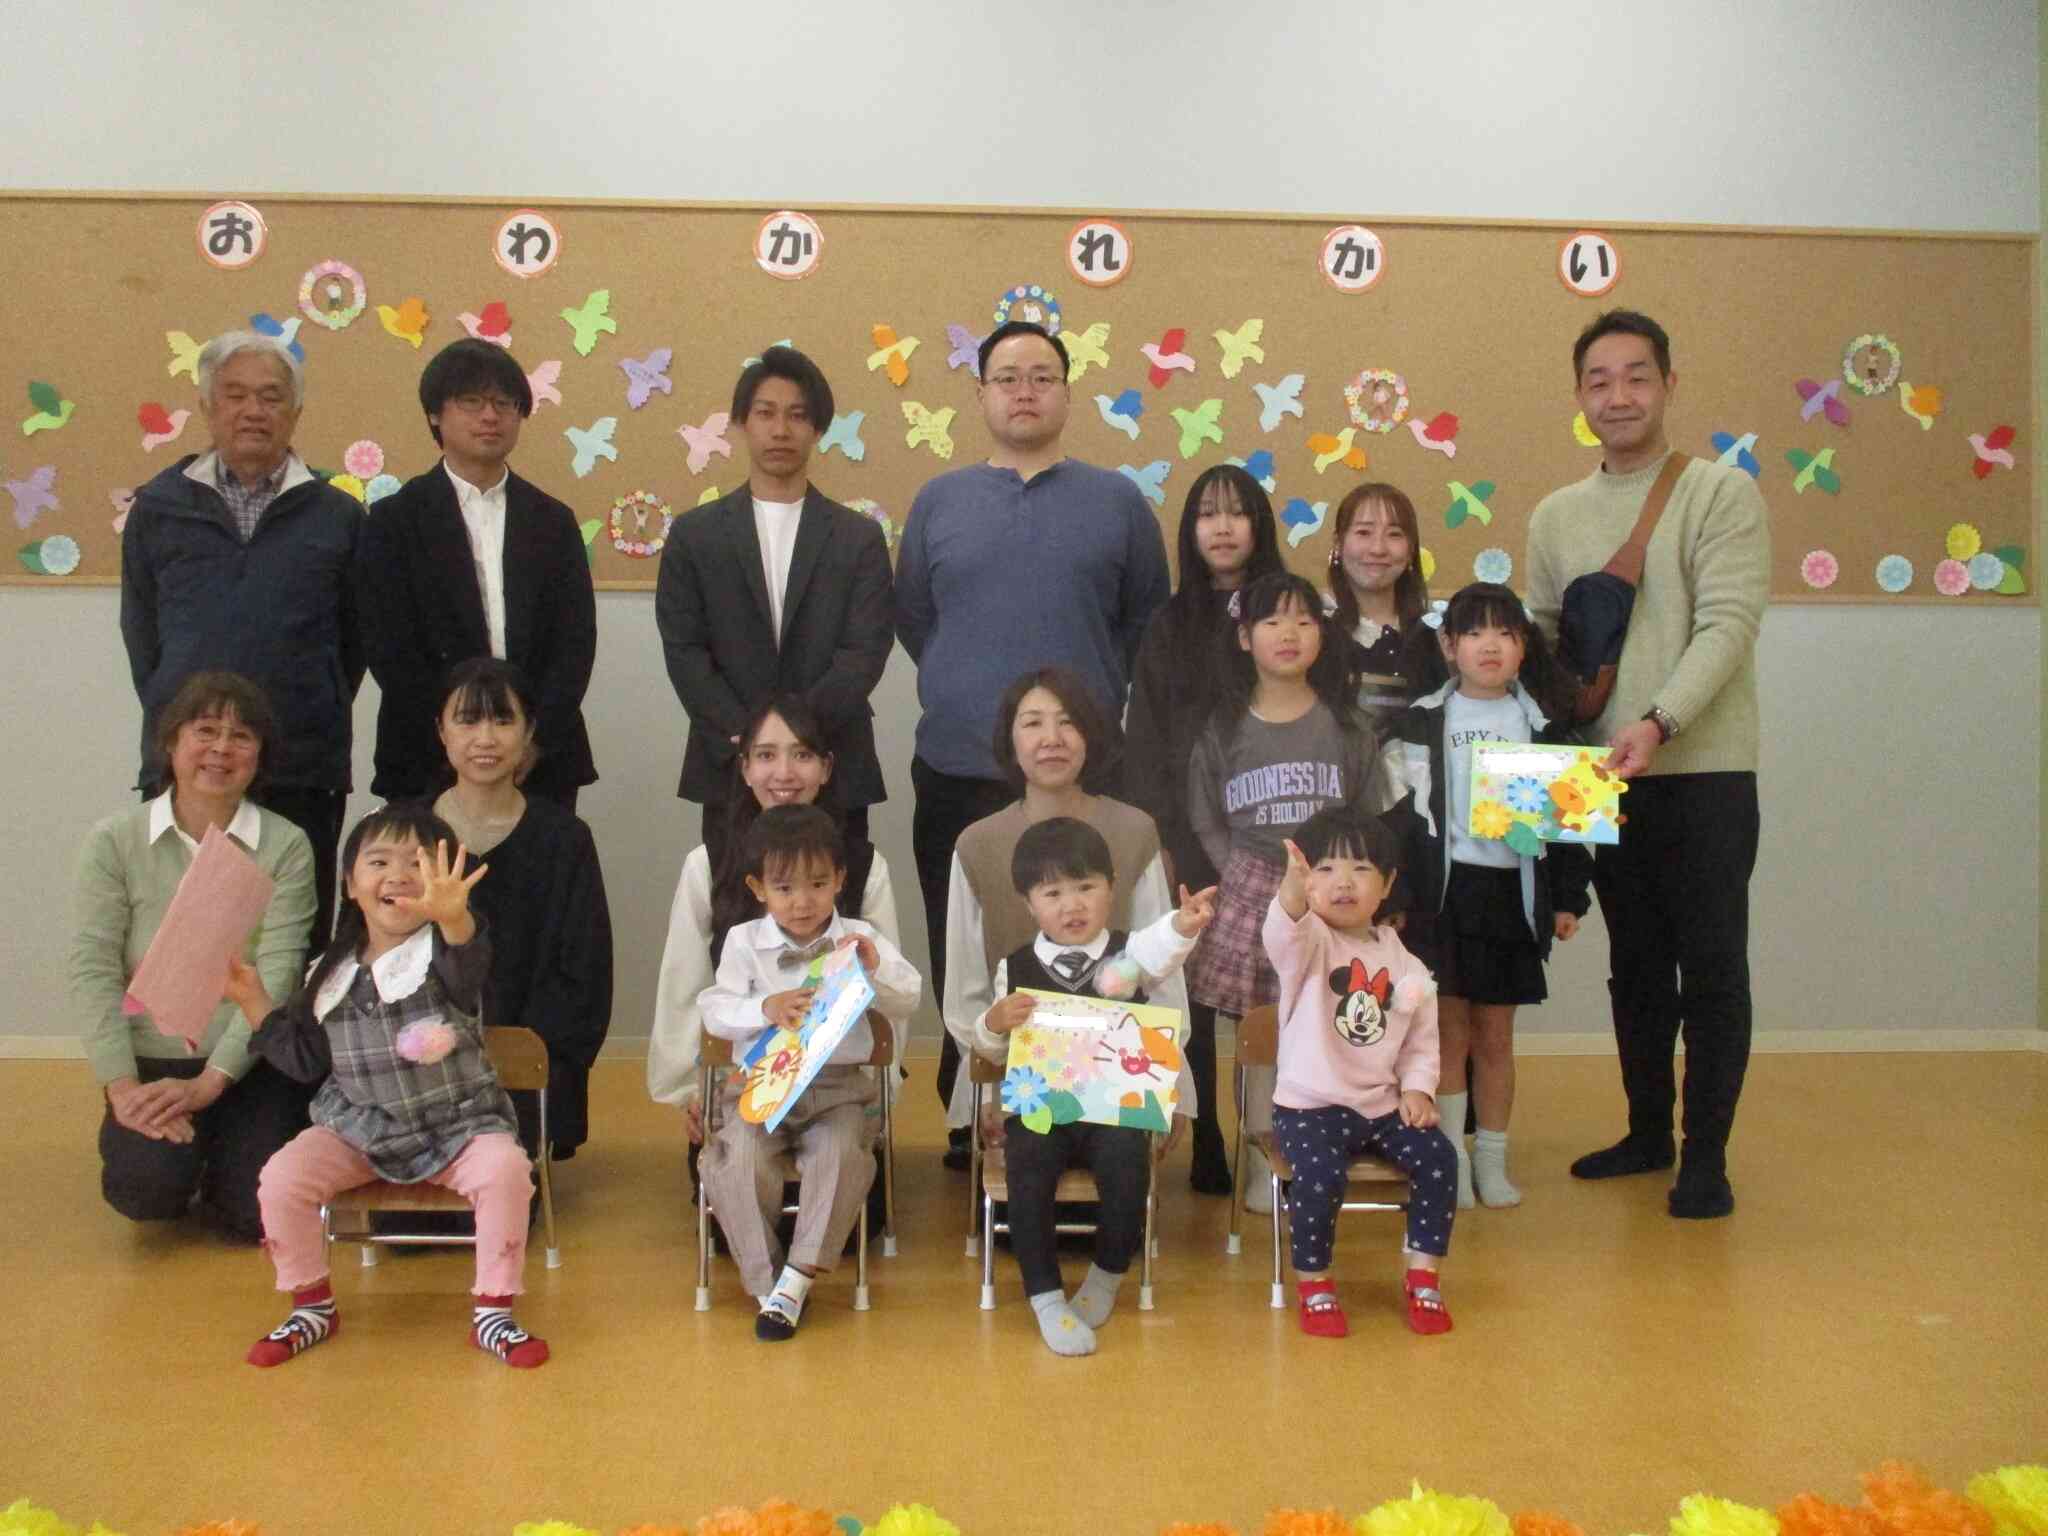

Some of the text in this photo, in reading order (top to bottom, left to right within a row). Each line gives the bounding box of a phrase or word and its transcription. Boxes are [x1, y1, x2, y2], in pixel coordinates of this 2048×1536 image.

[209, 212, 253, 256] お
[506, 222, 551, 265] わ
[767, 222, 813, 266] か
[1078, 229, 1121, 272] れ
[1331, 237, 1375, 280] か
[1225, 761, 1315, 813] GOODNESS
